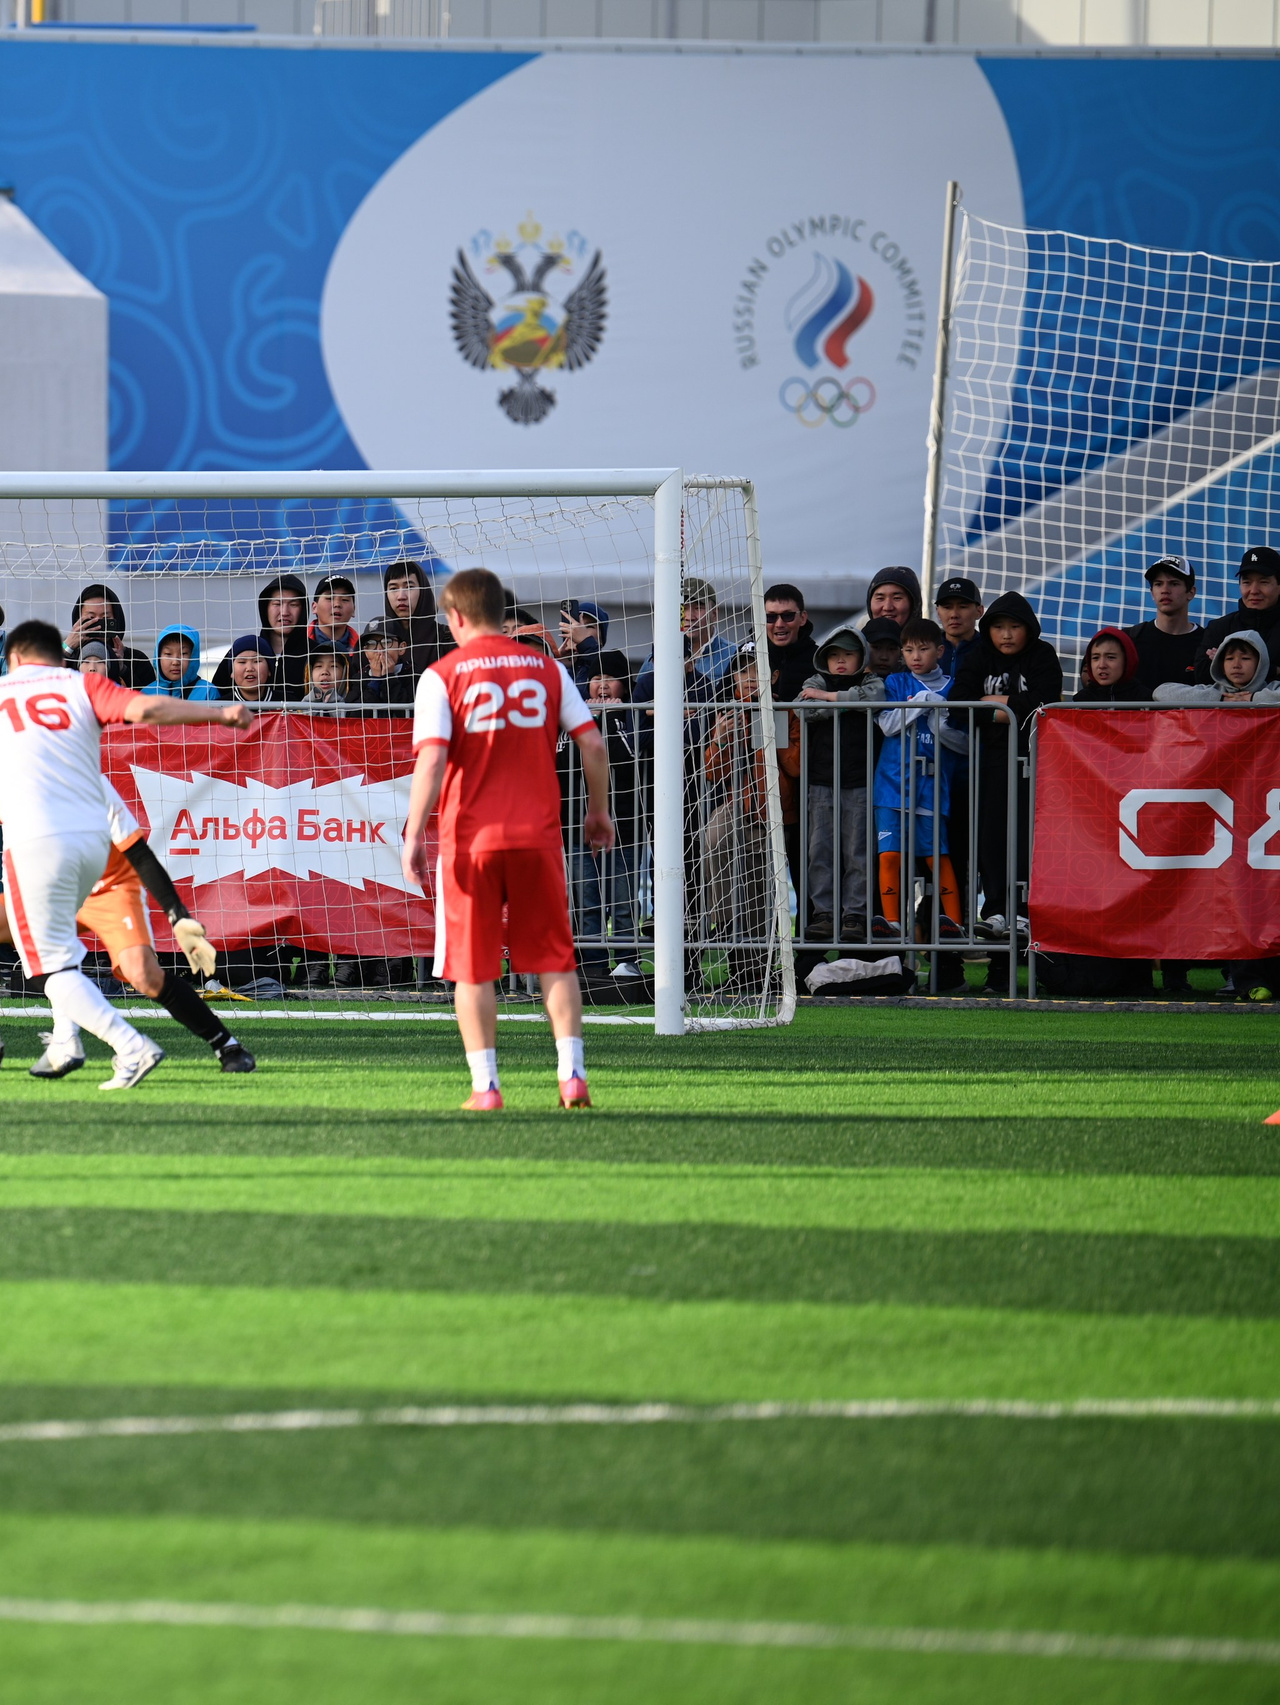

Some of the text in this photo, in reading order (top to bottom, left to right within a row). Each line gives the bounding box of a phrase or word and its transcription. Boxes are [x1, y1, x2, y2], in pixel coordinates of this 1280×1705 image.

[733, 213, 926, 371] RUSSIAN OLYMPIC COMMITTEE
[455, 655, 545, 675] АРШАВИН
[463, 678, 548, 734] 23
[170, 807, 388, 852] Альфа Банк
[122, 916, 133, 930] 1
